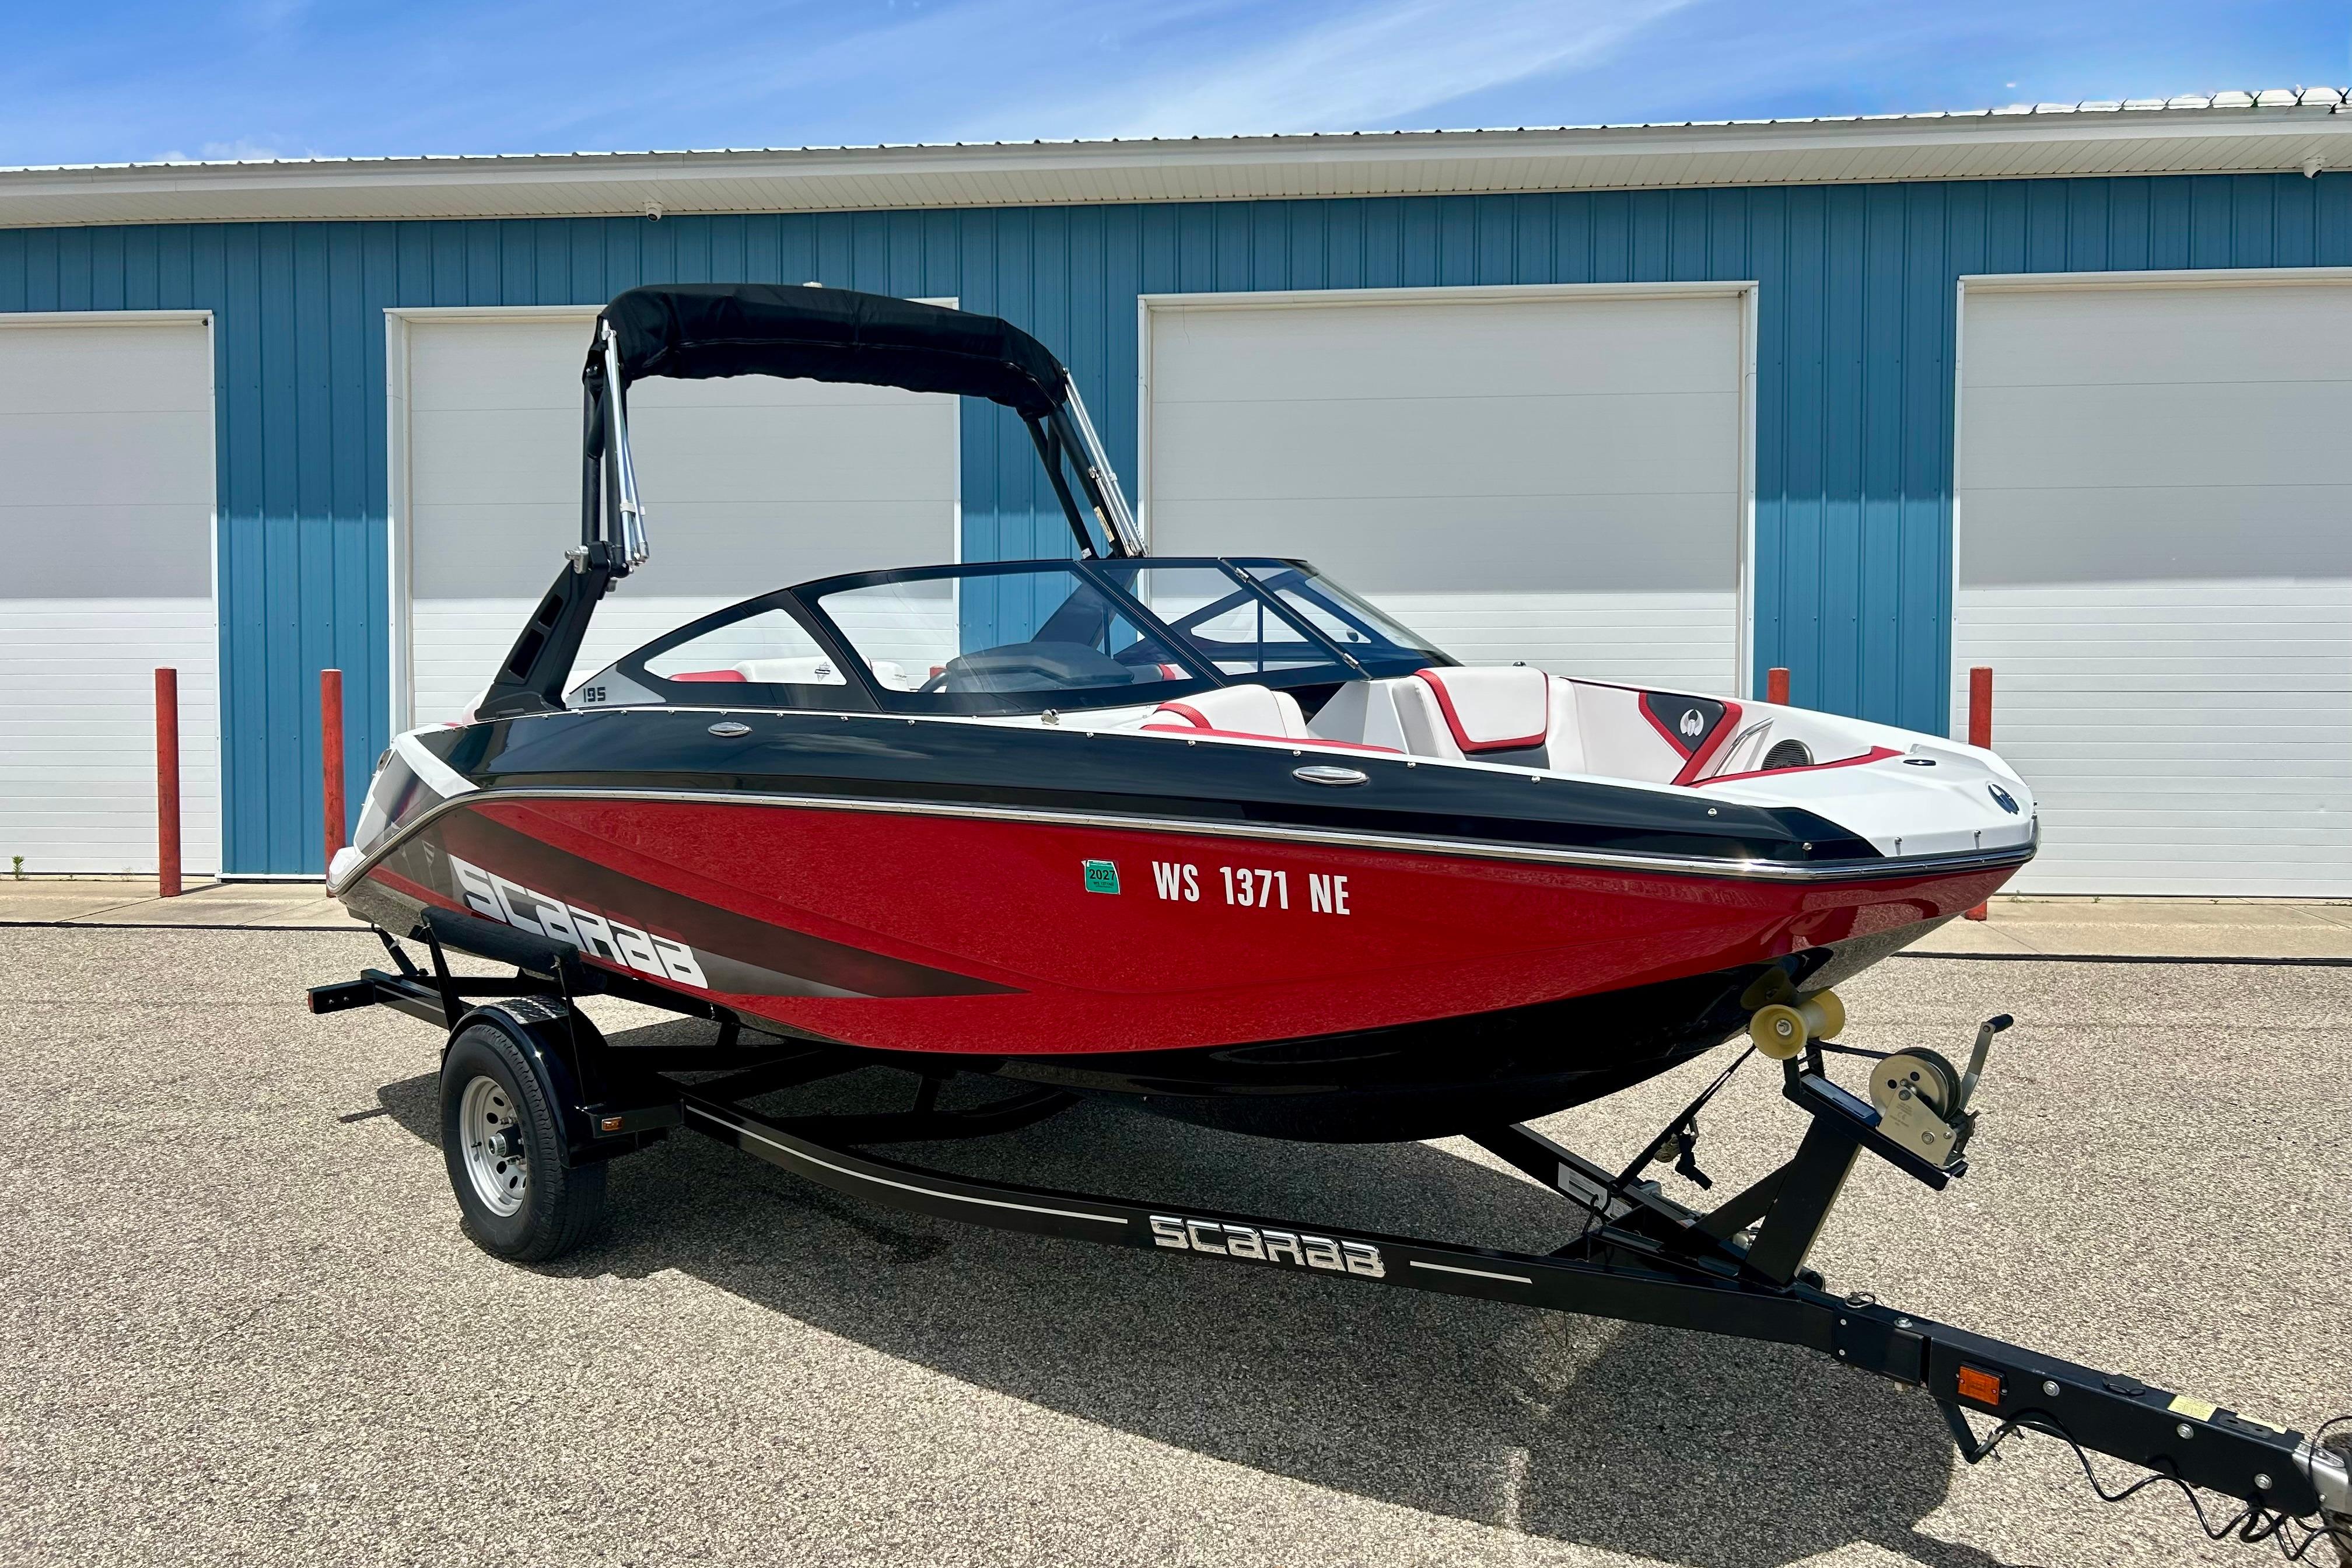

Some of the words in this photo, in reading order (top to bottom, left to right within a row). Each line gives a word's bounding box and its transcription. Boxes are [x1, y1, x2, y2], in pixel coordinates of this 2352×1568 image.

[583, 687, 606, 703] 195
[1088, 869, 1115, 880] 2027
[1152, 860, 1200, 902] WS
[1219, 866, 1289, 910] 1371
[1308, 873, 1350, 915] NE
[447, 853, 709, 989] SCARAB
[1149, 1215, 1387, 1278] SCARAB
